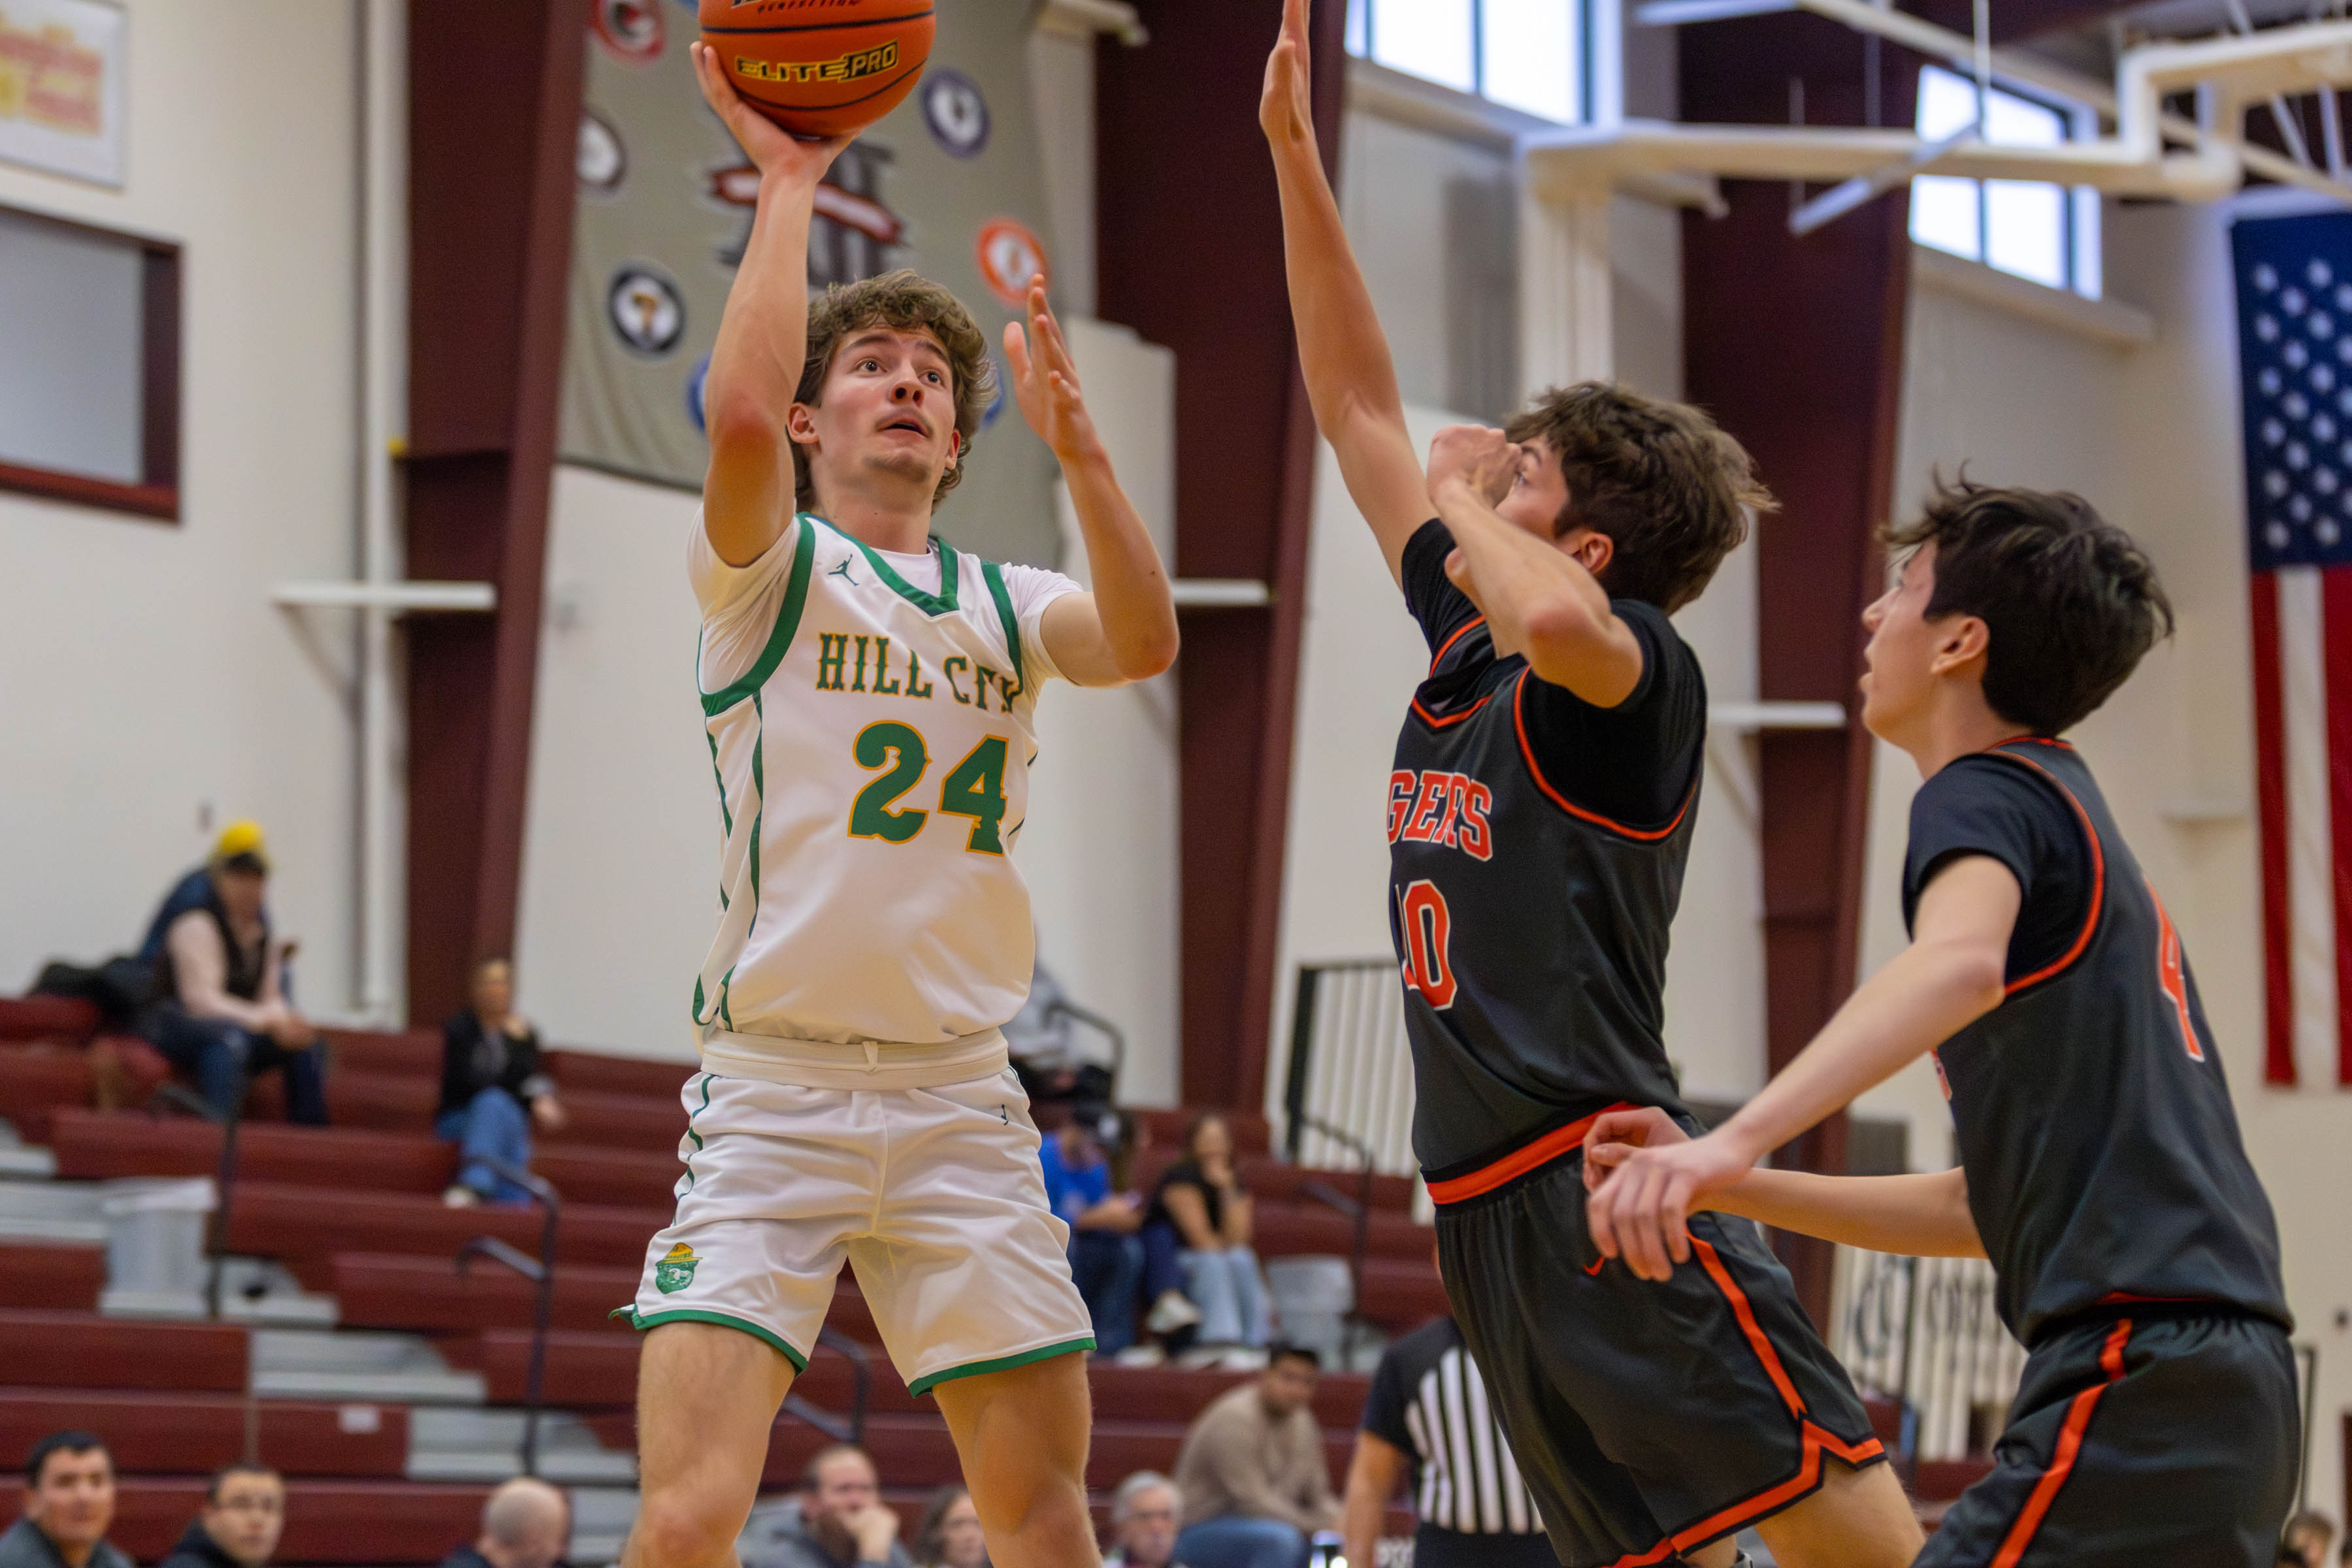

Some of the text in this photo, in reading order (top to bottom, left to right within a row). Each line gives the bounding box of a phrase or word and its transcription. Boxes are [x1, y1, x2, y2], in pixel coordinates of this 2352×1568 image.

[849, 41, 898, 78] PRO
[816, 632, 933, 700] HILL
[847, 720, 1011, 857] 24
